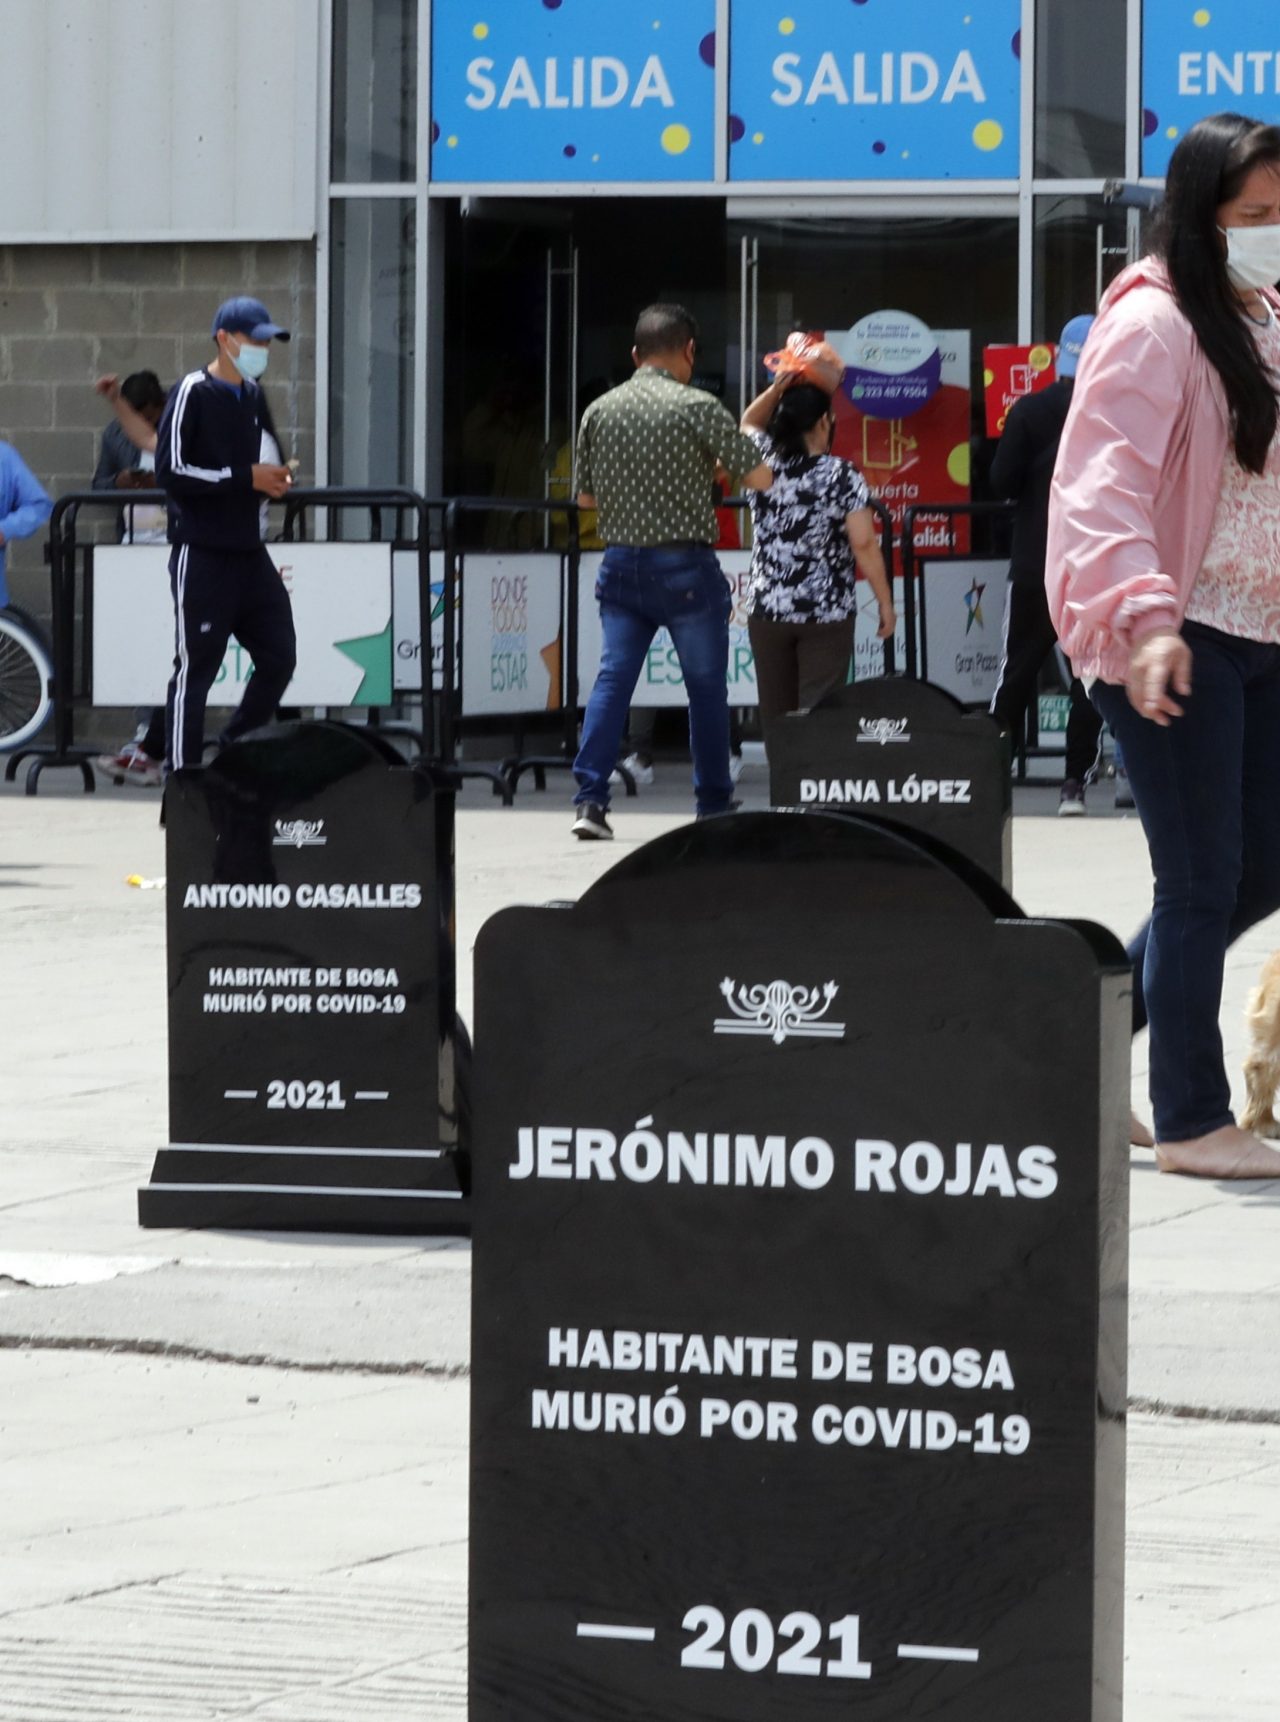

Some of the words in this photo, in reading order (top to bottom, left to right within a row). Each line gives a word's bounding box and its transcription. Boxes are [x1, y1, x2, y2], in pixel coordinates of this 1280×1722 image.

[466, 55, 674, 109] SALIDA
[771, 51, 985, 105] SALIDA
[912, 525, 956, 547] alida
[490, 652, 528, 691] ESTAR
[800, 779, 880, 803] DIANA
[887, 773, 972, 803] LÓPEZ
[183, 883, 291, 909] ANTONIO
[295, 883, 422, 909] CASALLES
[209, 967, 311, 987] HABITANTE
[315, 967, 342, 987] DE
[345, 967, 399, 987] BOSA
[203, 989, 267, 1013] MURIÓ
[271, 993, 312, 1013] POR
[316, 994, 406, 1014] COVID-19
[266, 1079, 346, 1110] 2021
[508, 1114, 836, 1190] JERÓNIMO
[854, 1138, 1059, 1199] ROJAS
[548, 1327, 799, 1379] HABITANTE
[811, 1340, 874, 1383] DE
[886, 1344, 1015, 1391] BOSA
[531, 1384, 687, 1436] MURIÓ
[700, 1397, 798, 1443] POR
[811, 1403, 1031, 1455] COVID-19
[680, 1604, 872, 1679] 2021
